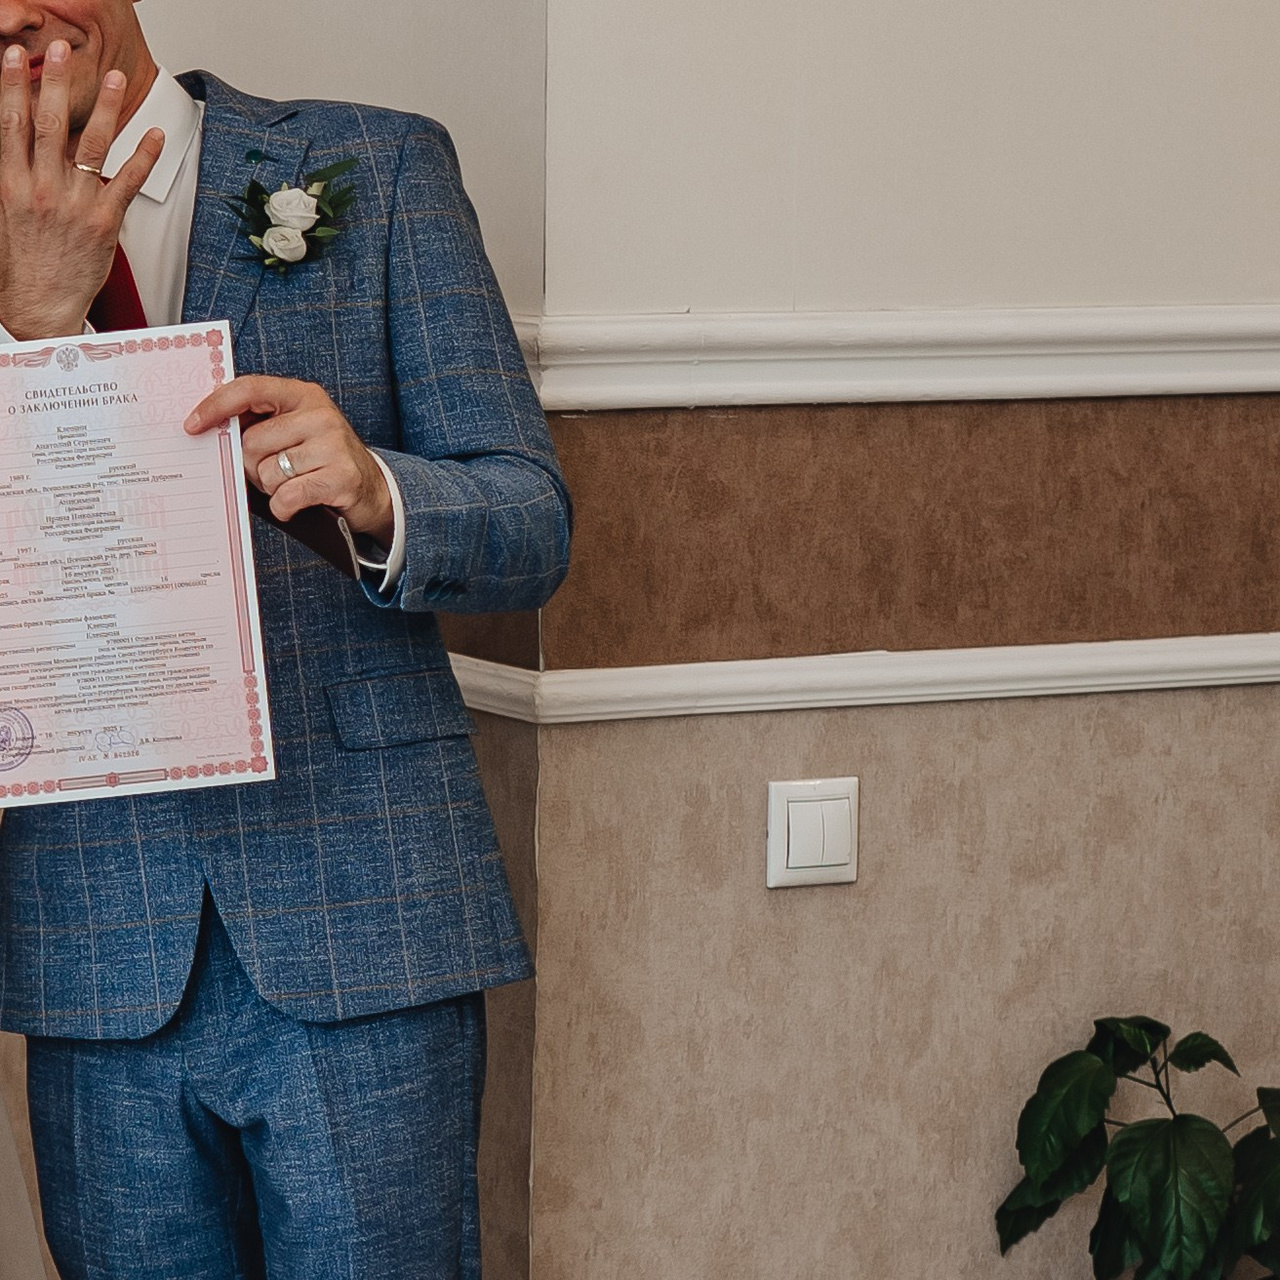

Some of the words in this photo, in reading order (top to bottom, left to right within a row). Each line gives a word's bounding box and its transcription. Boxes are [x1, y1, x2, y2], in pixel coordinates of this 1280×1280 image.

[23, 381, 118, 400] СВИДЕТЕЛЬСТВО
[7, 405, 16, 415] О
[18, 396, 99, 414] ЗАКЛЮЧЕНИИ
[101, 392, 139, 405] БРАКА
[34, 440, 72, 450] Анатолий
[72, 437, 111, 446] Сергеевич
[35, 455, 75, 464] Российская
[75, 451, 113, 461] Федерация
[45, 514, 70, 523] Ирина
[43, 528, 83, 537] Российская
[83, 524, 121, 534] Федерация
[116, 536, 143, 545] русская
